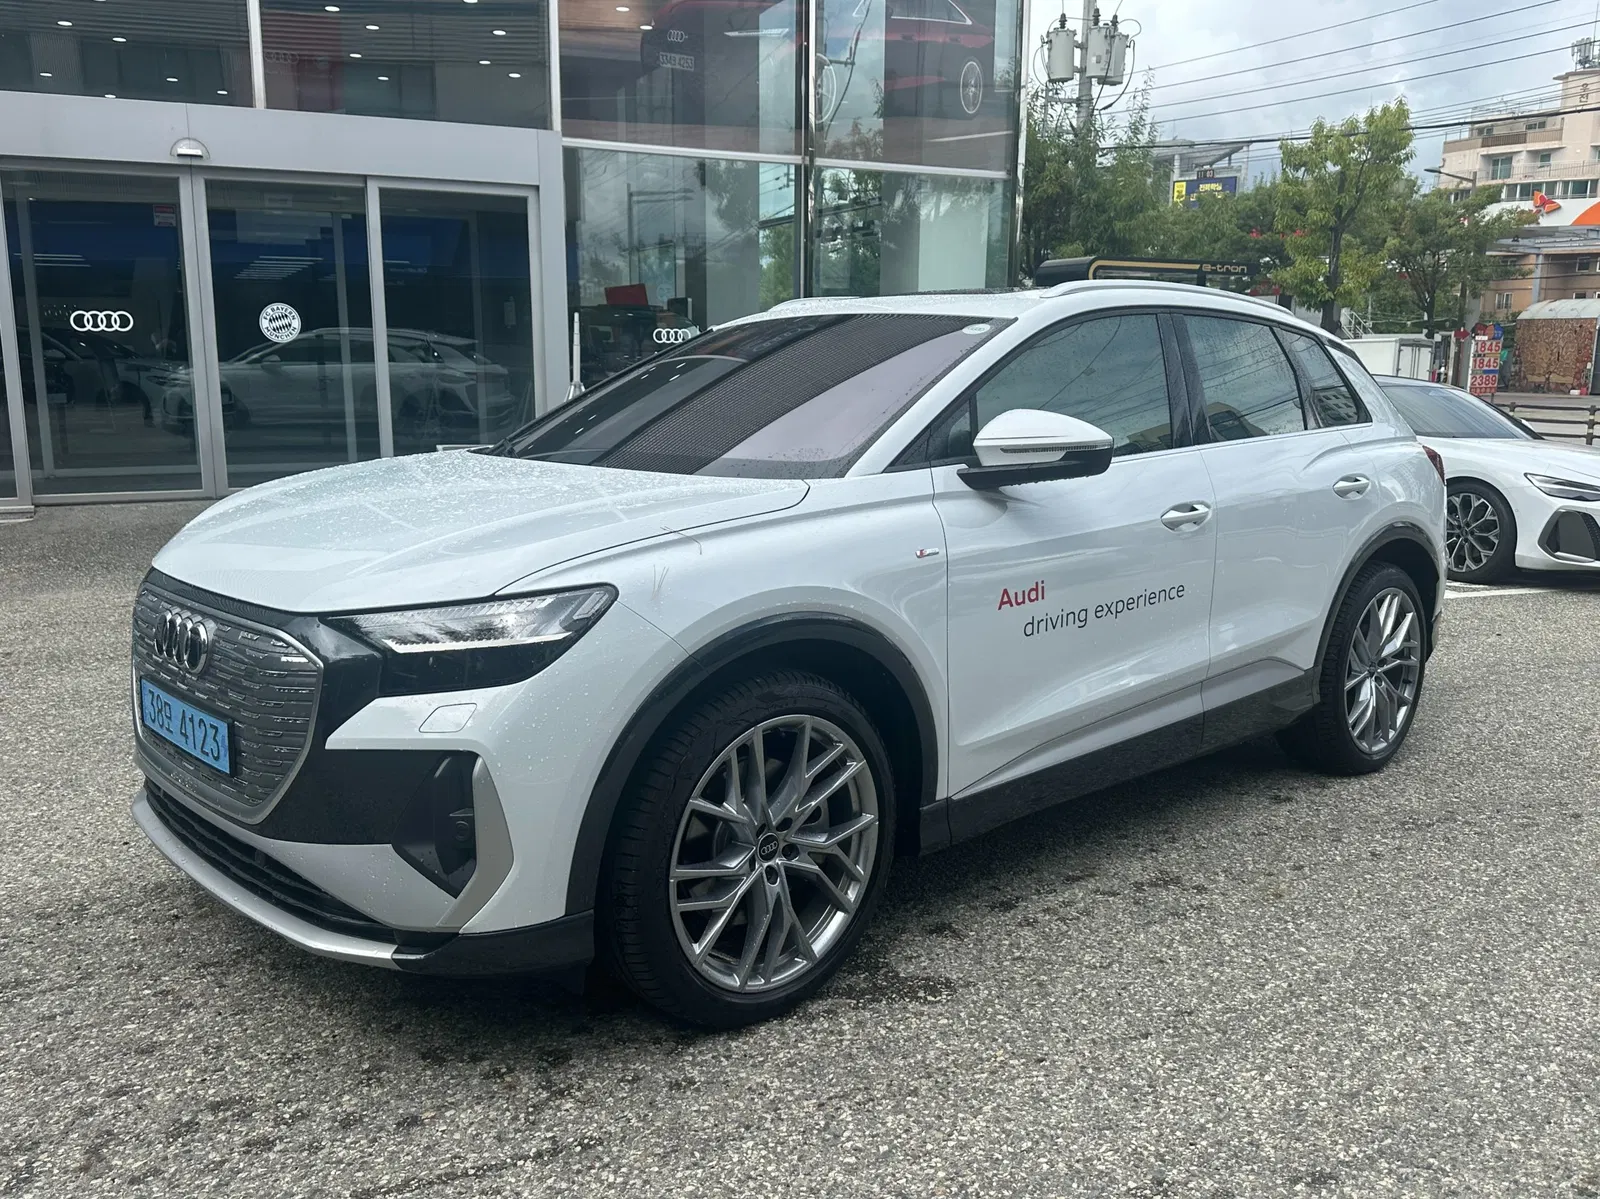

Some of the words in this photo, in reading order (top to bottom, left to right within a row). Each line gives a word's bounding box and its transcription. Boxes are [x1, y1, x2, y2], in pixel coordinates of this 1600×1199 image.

[1202, 263, 1247, 274] e-tron
[263, 311, 271, 320] FC
[270, 306, 297, 320] BAYERN
[1474, 341, 1501, 353] 1845
[1472, 358, 1499, 369] 1845
[1471, 375, 1497, 387] 2389
[997, 580, 1046, 611] Audi
[1022, 606, 1089, 638] driving
[1093, 583, 1186, 620] experience
[179, 708, 220, 762] 4123
